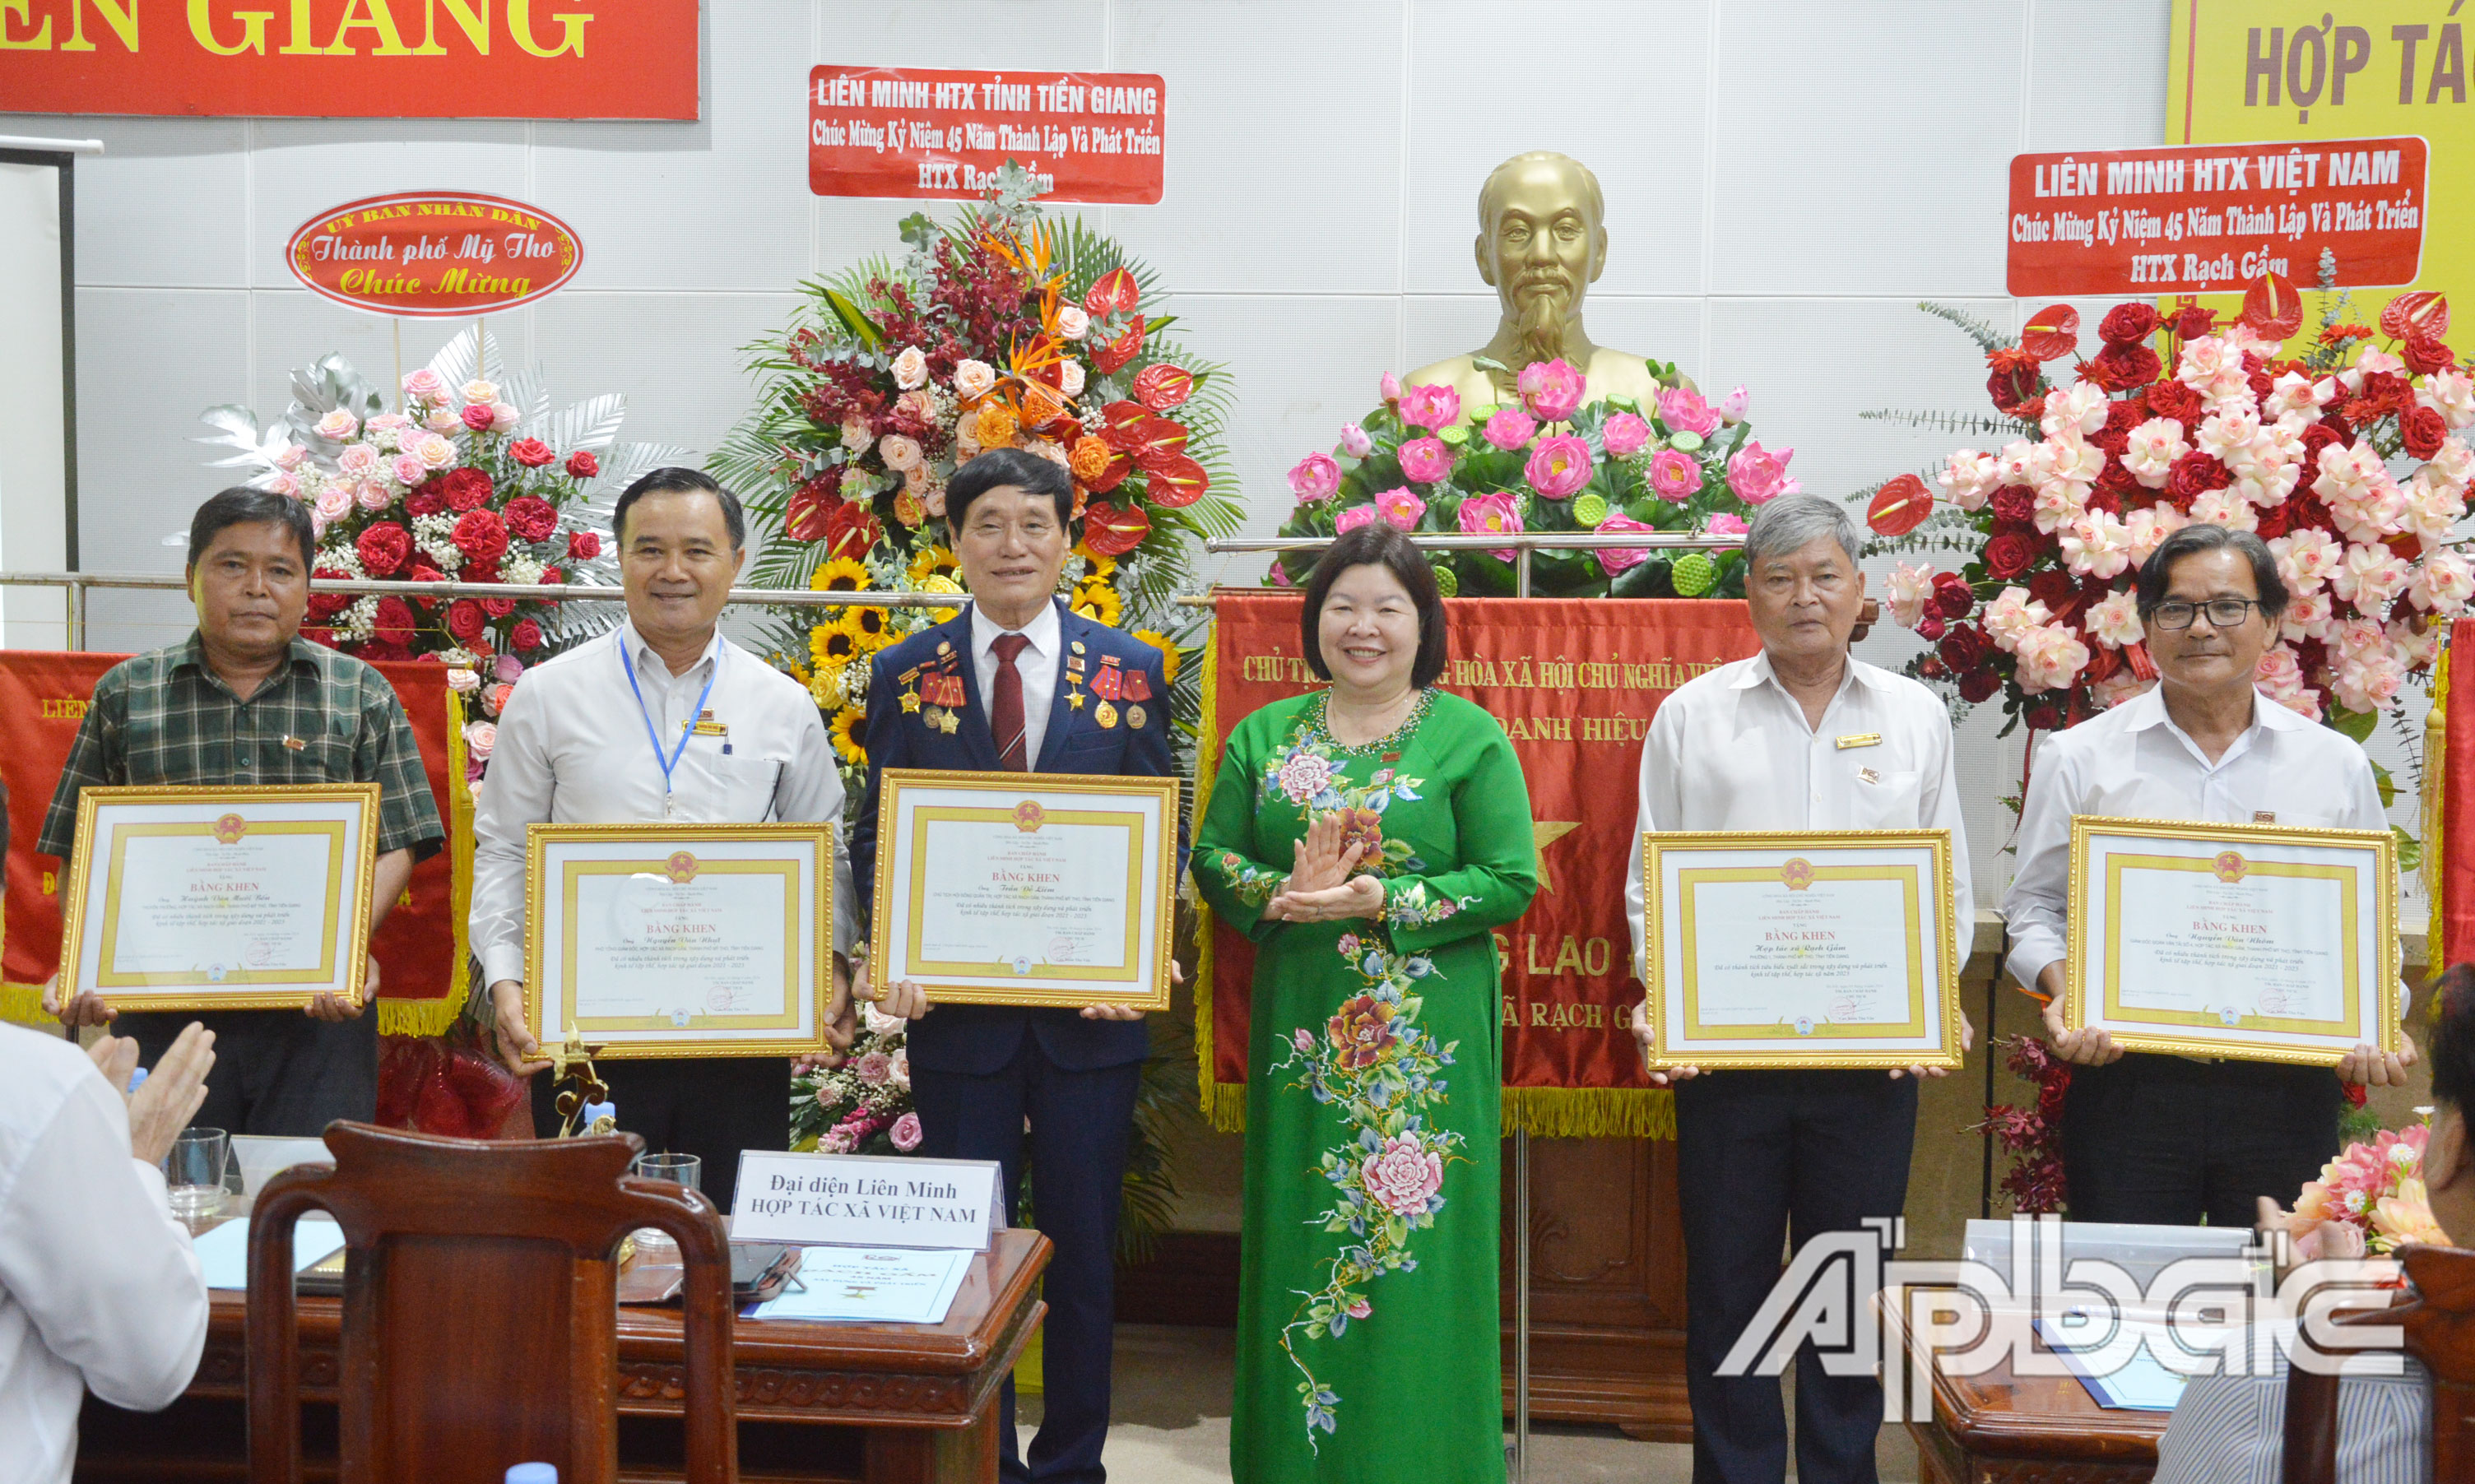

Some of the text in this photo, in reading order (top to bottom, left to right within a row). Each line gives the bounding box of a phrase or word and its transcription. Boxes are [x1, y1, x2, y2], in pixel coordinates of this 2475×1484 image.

[187, 0, 594, 57] GIANG
[2245, 0, 2475, 124] HỢP TÁ
[817, 73, 1157, 115] LIÊN MINH HTX TỈNH TIỀN GIANG
[812, 118, 1161, 160] Chúc Mừng Kỷ Niệm 45 Năm Thành Lập Và Phát Triển
[918, 163, 959, 190] HTX
[2035, 147, 2400, 197] LIÊN MINH HTX VIỆT NAM
[362, 204, 411, 225] BAN
[417, 202, 486, 218] NHÂN
[490, 208, 542, 232] DÂN
[2013, 189, 2419, 248] Chúc Mừng Kỷ Niệm 45 Năm Thành Lập Và Phát Triển
[311, 232, 557, 267] Thành phố Mỹ Tho
[339, 267, 534, 299] Chúc Mừng
[2130, 253, 2178, 283] HTX
[2182, 252, 2235, 289] Rạch
[1242, 646, 1284, 682] CHỦ
[1454, 651, 1499, 688] HÒA
[1501, 655, 1535, 689] XÃ
[1539, 655, 1575, 697] HỘI
[1578, 652, 1620, 689] CHỦ
[1622, 656, 1686, 689] NGHĨA
[1582, 711, 1648, 748] HIỆU
[226, 882, 260, 892] KHEN
[1027, 873, 1061, 883] KHEN
[683, 923, 717, 934] KHEN
[1765, 927, 1836, 941] BẰNG KHEN
[2231, 923, 2268, 934] KHEN
[1528, 933, 1611, 977] LAO
[1530, 1002, 1603, 1033] RẠCH
[770, 1173, 958, 1200] Đại diện Liên Minh
[750, 1197, 977, 1225] HỢP TÁC XÃ VIỆT NAM
